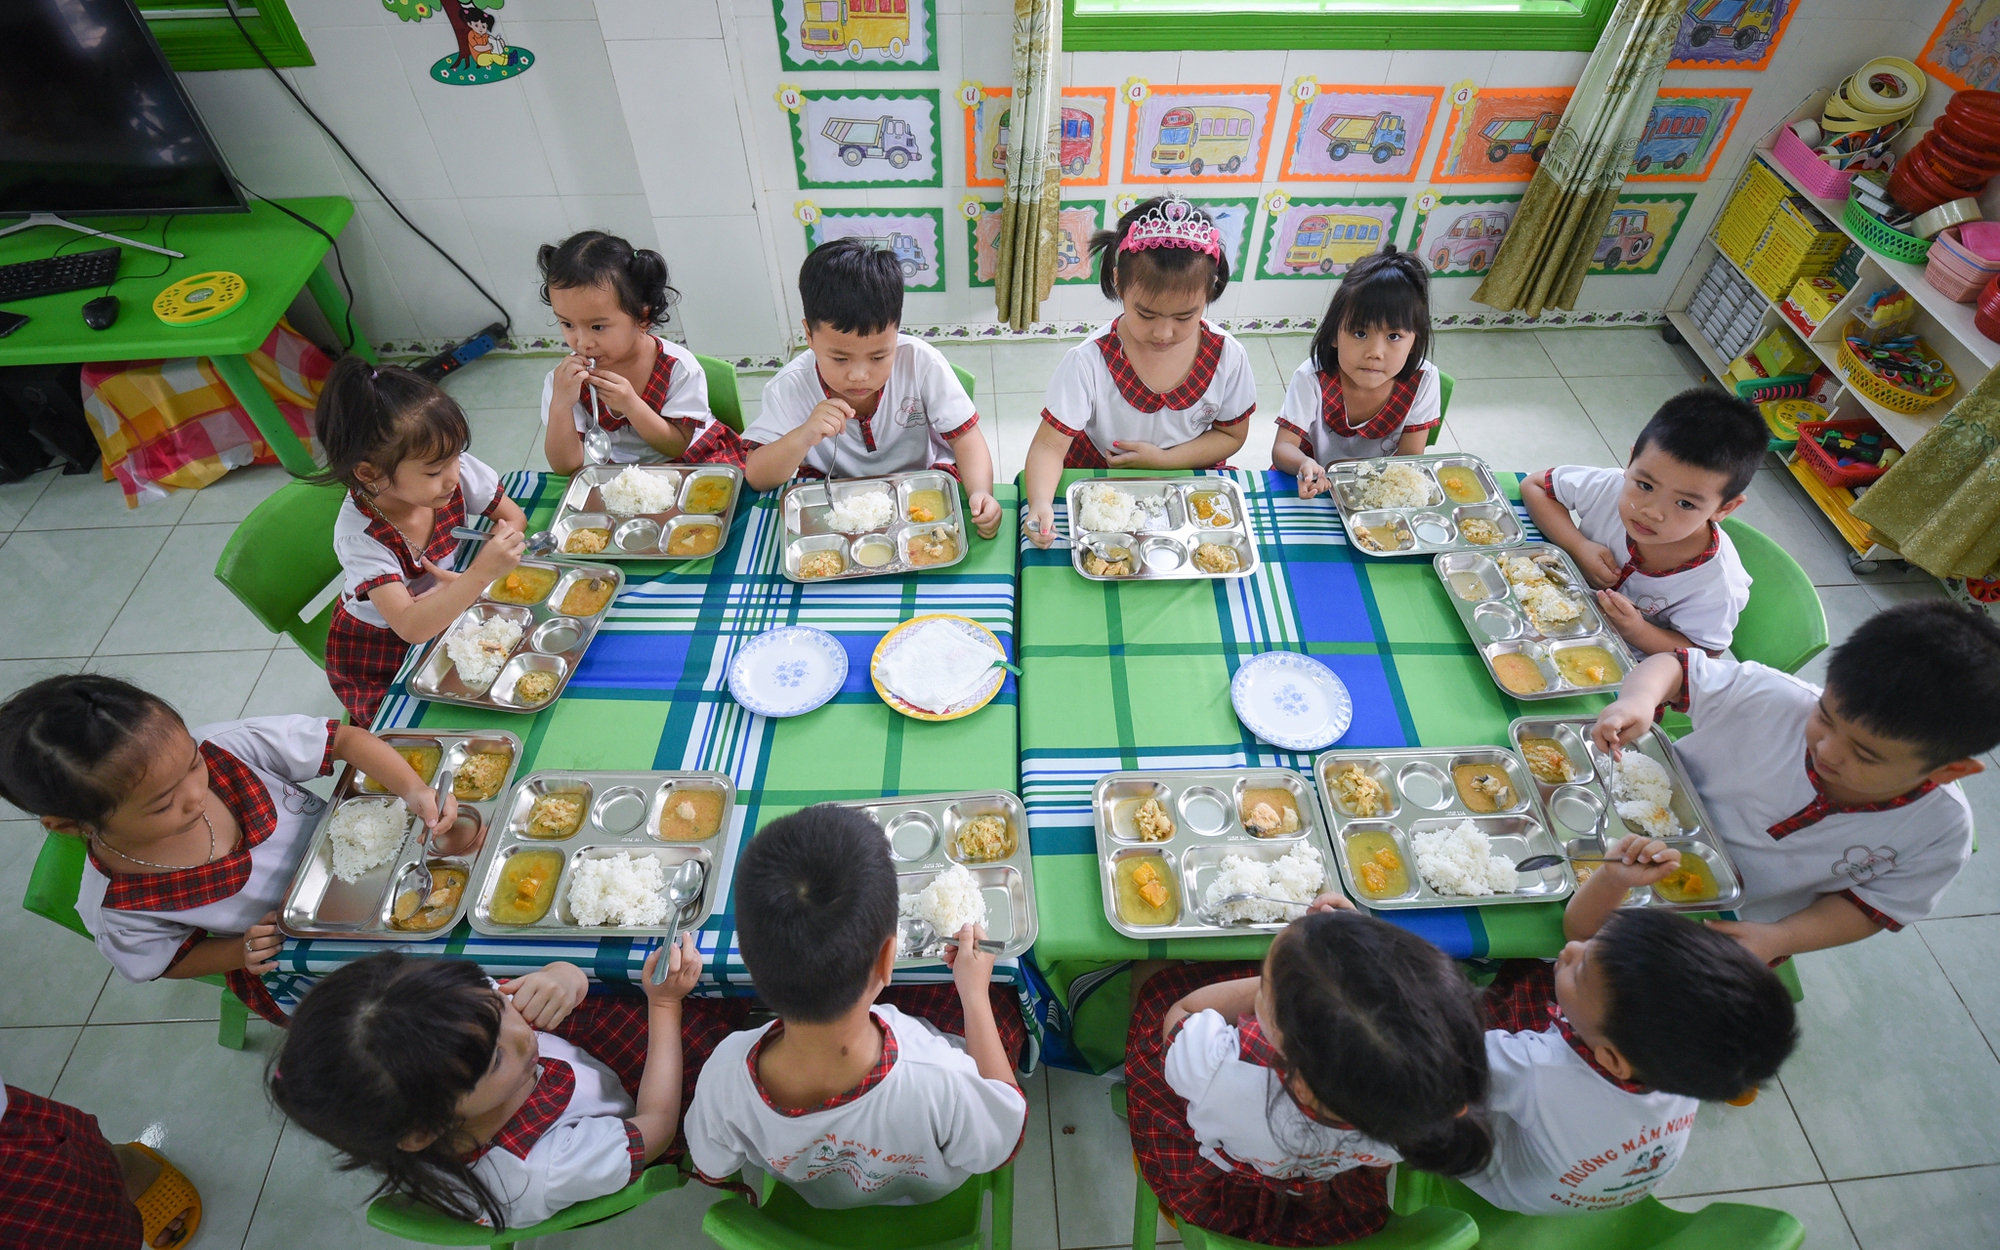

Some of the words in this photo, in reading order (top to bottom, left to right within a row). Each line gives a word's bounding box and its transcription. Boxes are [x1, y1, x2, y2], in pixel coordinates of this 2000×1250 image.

[965, 88, 977, 102] ư
[1131, 86, 1142, 98] a
[1300, 85, 1310, 96] n
[1457, 88, 1469, 102] â
[785, 94, 796, 105] u
[1123, 200, 1130, 211] t
[1422, 197, 1431, 208] q
[803, 209, 813, 221] h
[966, 203, 977, 216] ô
[1558, 1149, 1619, 1188] TRƯỜNG
[1621, 1125, 1661, 1154] MẦM
